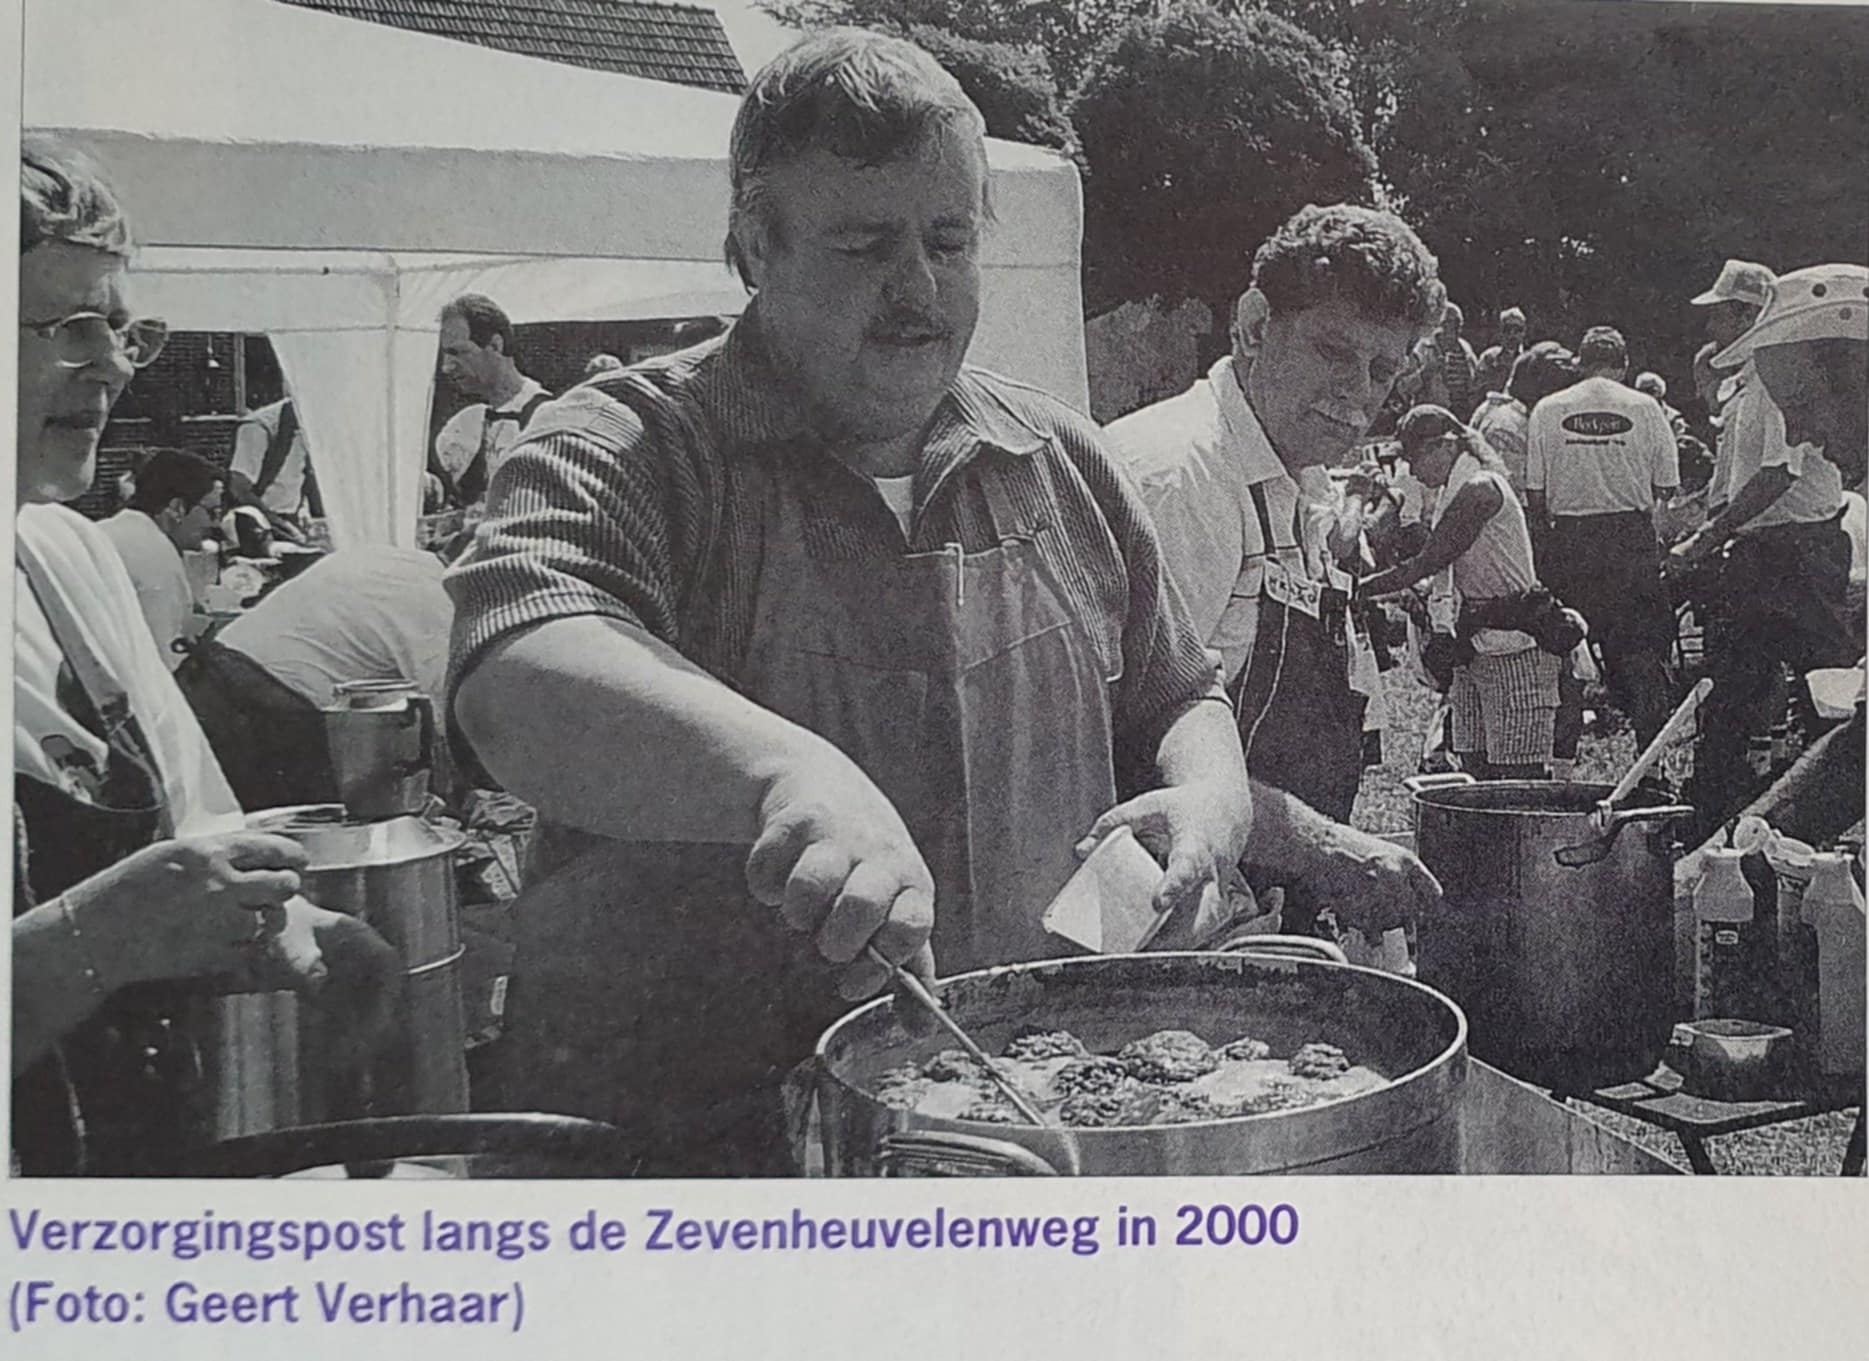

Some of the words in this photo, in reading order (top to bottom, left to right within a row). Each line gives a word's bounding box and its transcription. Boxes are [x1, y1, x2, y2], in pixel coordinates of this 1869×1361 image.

[8, 1209, 406, 1261] Verzorgingspost
[422, 1210, 551, 1261] langs
[569, 1210, 626, 1252] de
[645, 1208, 1100, 1256] Zevenheuvelenweg
[1118, 1205, 1156, 1247] in
[1175, 1203, 1299, 1246] 2000
[9, 1280, 145, 1332] (Foto:
[165, 1281, 300, 1324] Geert
[315, 1281, 525, 1332] Verhaar)
